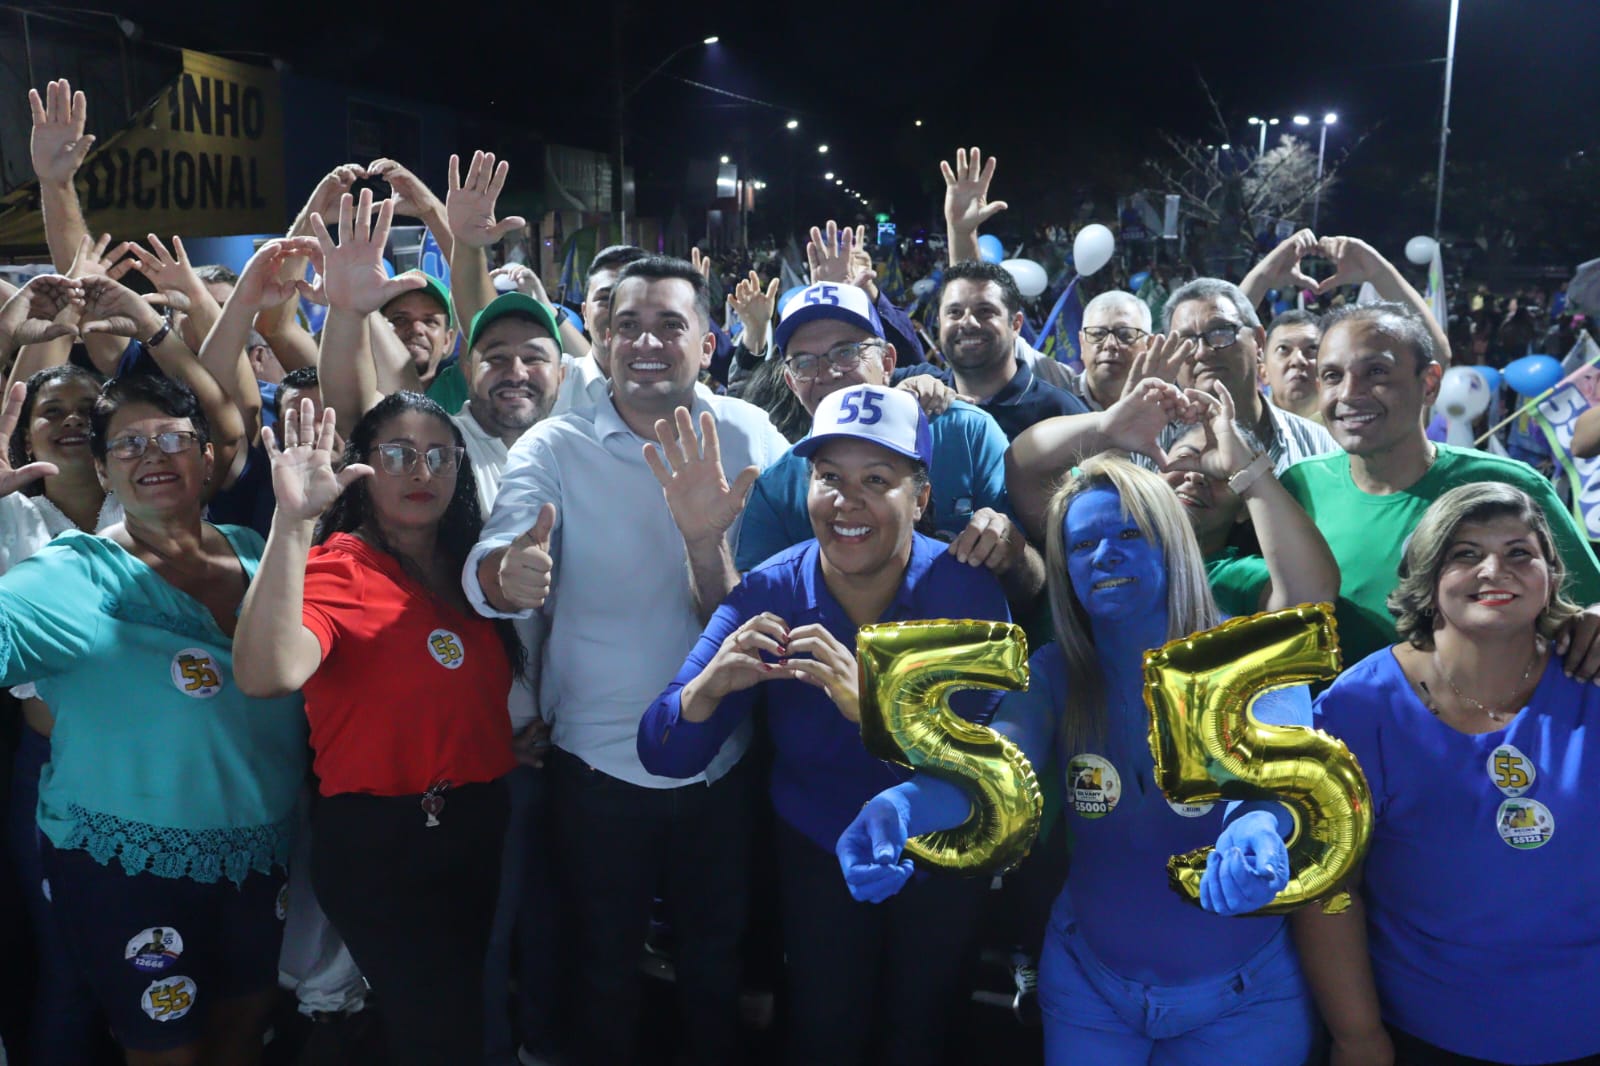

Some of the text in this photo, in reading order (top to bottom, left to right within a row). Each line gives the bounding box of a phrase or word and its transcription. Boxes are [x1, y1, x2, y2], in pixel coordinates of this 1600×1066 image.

[804, 285, 840, 306] 55
[837, 390, 885, 425] 55
[431, 634, 462, 665] 55
[178, 656, 219, 691] 55
[1494, 755, 1529, 788] 55
[1075, 801, 1107, 813] 55000
[1512, 835, 1542, 844] 55123
[149, 980, 191, 1017] 55
